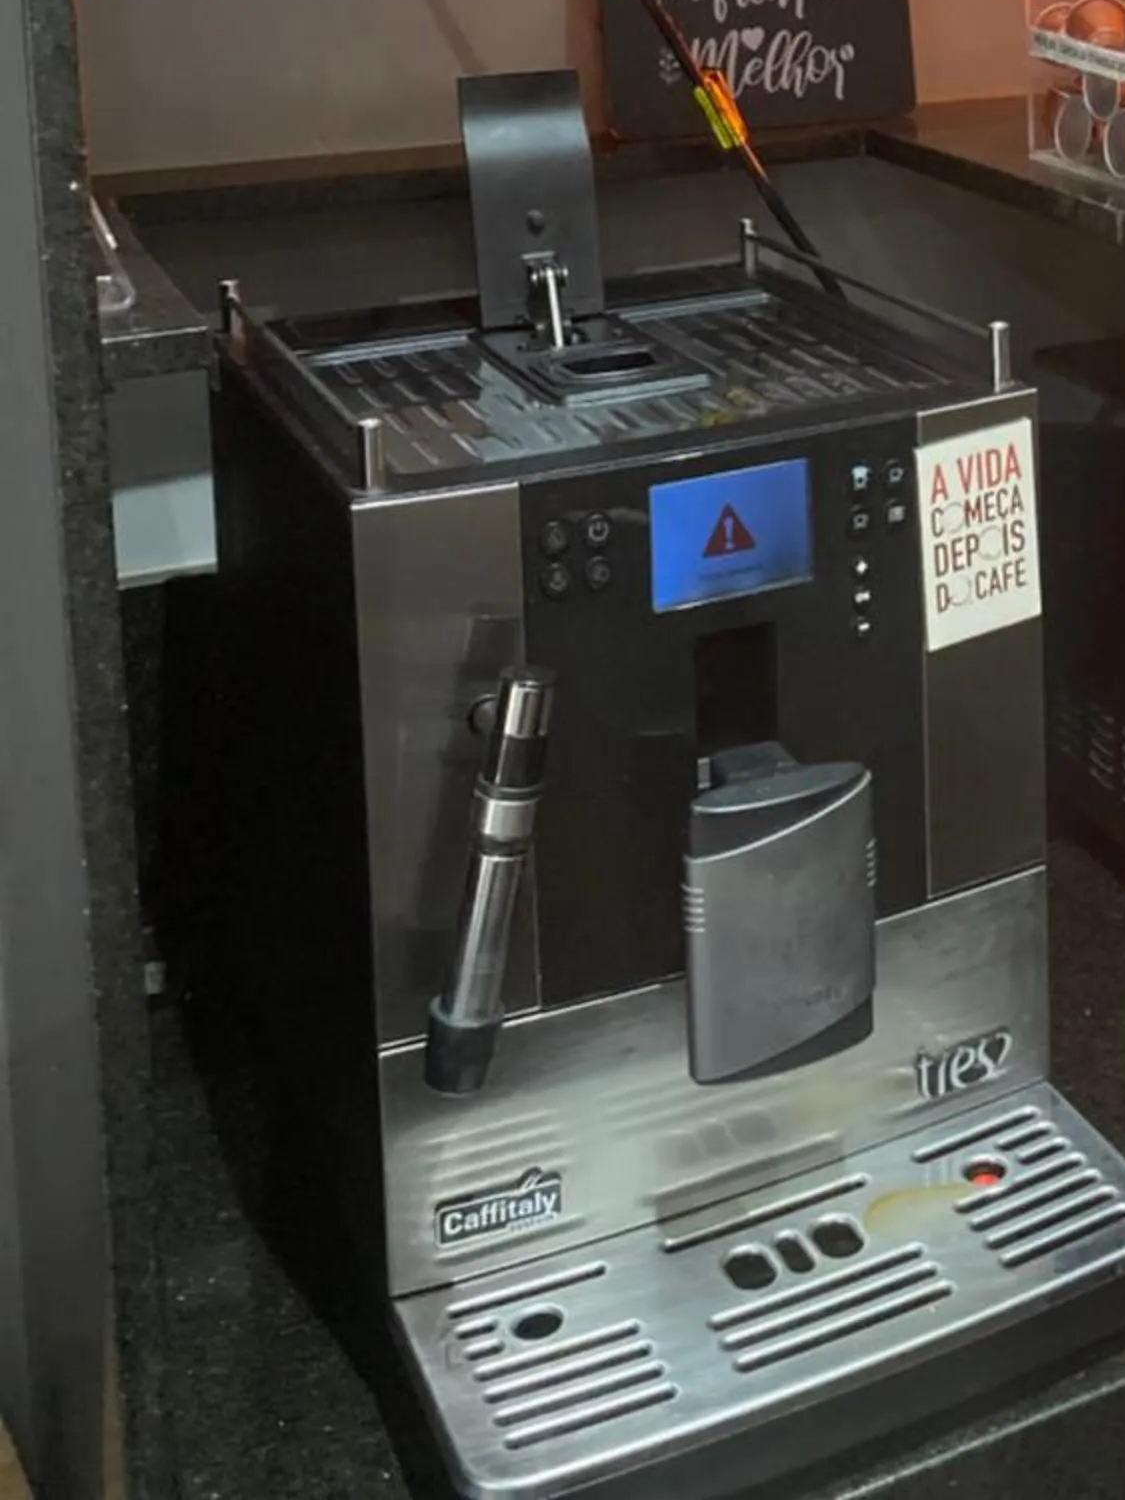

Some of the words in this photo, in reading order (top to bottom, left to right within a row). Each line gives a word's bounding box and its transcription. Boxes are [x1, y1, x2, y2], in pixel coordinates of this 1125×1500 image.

[930, 464, 950, 505] A
[956, 443, 1023, 495] VIDA
[443, 1190, 557, 1236] Caffitaly
